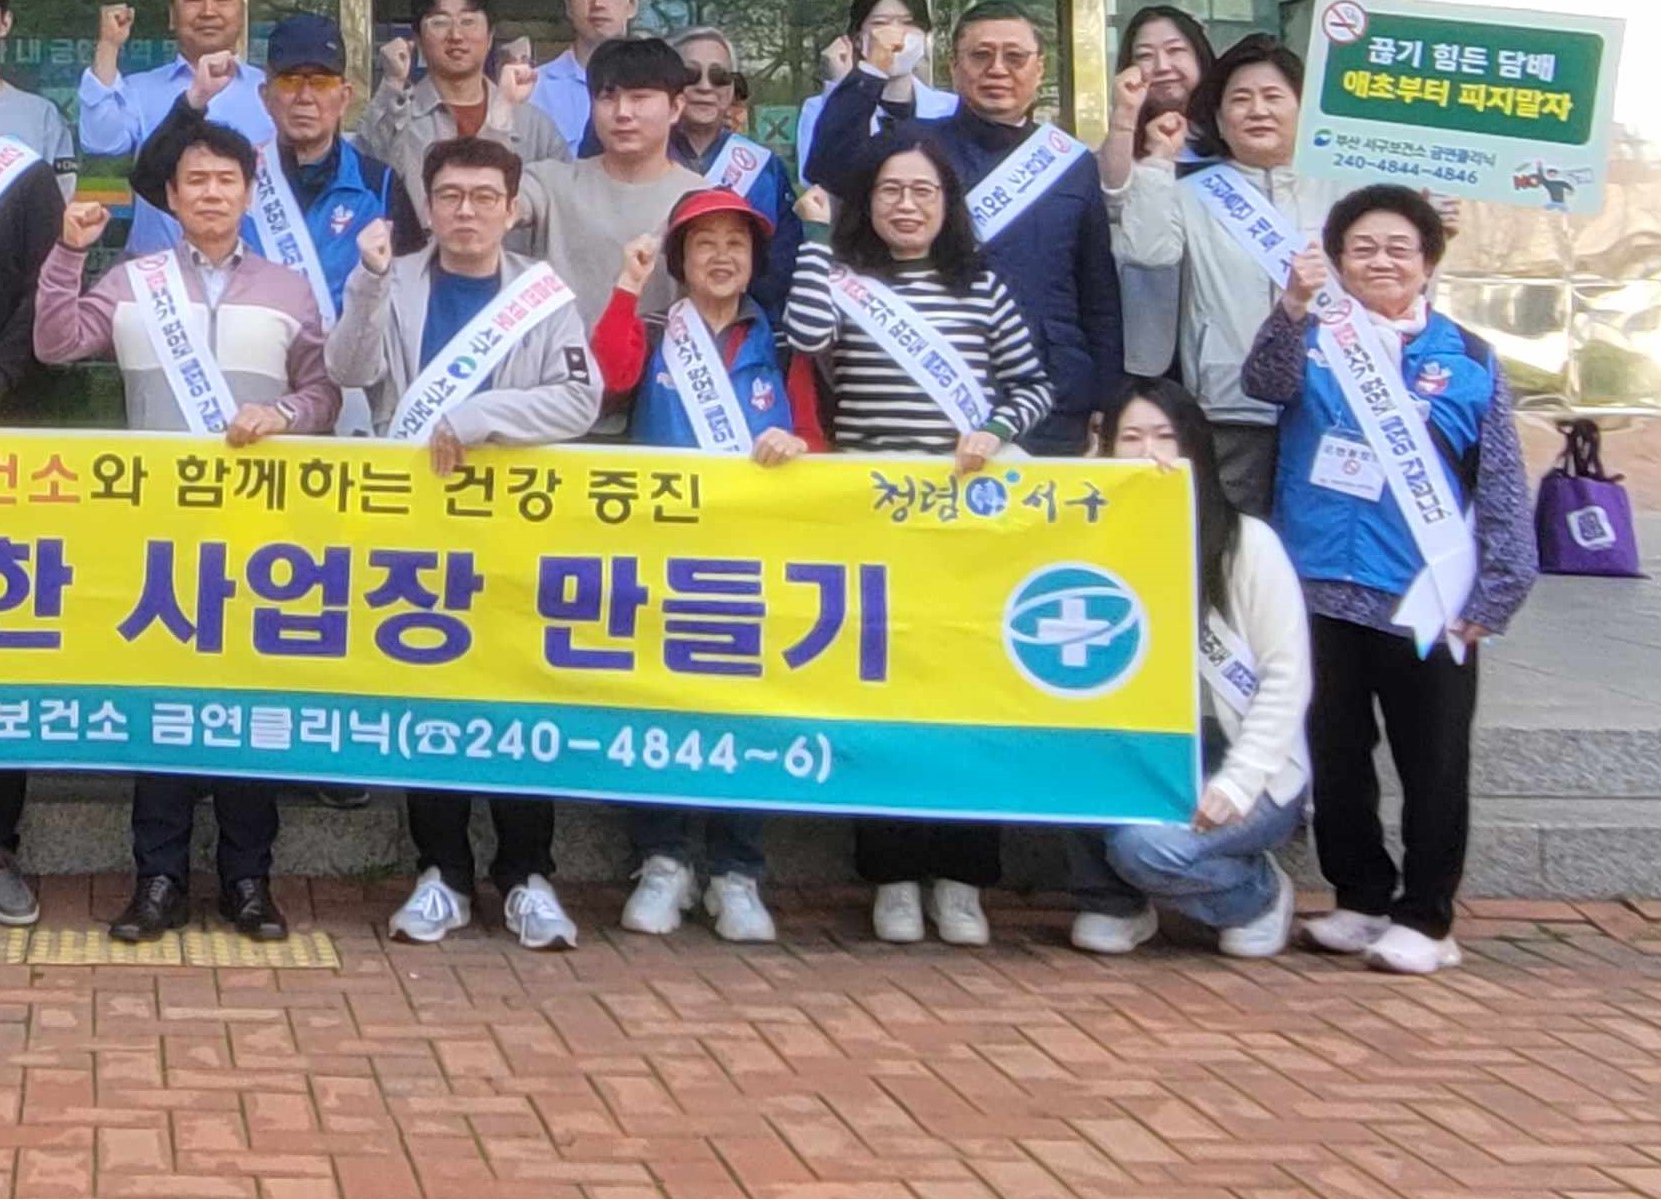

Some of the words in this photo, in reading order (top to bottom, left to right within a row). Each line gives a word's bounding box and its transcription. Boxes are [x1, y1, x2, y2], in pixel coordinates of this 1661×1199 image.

[1368, 35, 1423, 68] 끊기
[1432, 42, 1488, 75] 힘든
[1497, 49, 1556, 83] 담배
[1343, 69, 1450, 107] 애초부터
[1458, 82, 1573, 122] 피지말자
[1333, 153, 1478, 184] 240-4844-4846
[469, 328, 502, 356] 서구
[177, 455, 414, 514] 함께하는
[443, 464, 561, 523] 건강
[588, 468, 702, 525] 증진
[1022, 479, 1109, 524] 서구
[117, 540, 484, 665] 사업장
[538, 553, 889, 683] 만들기
